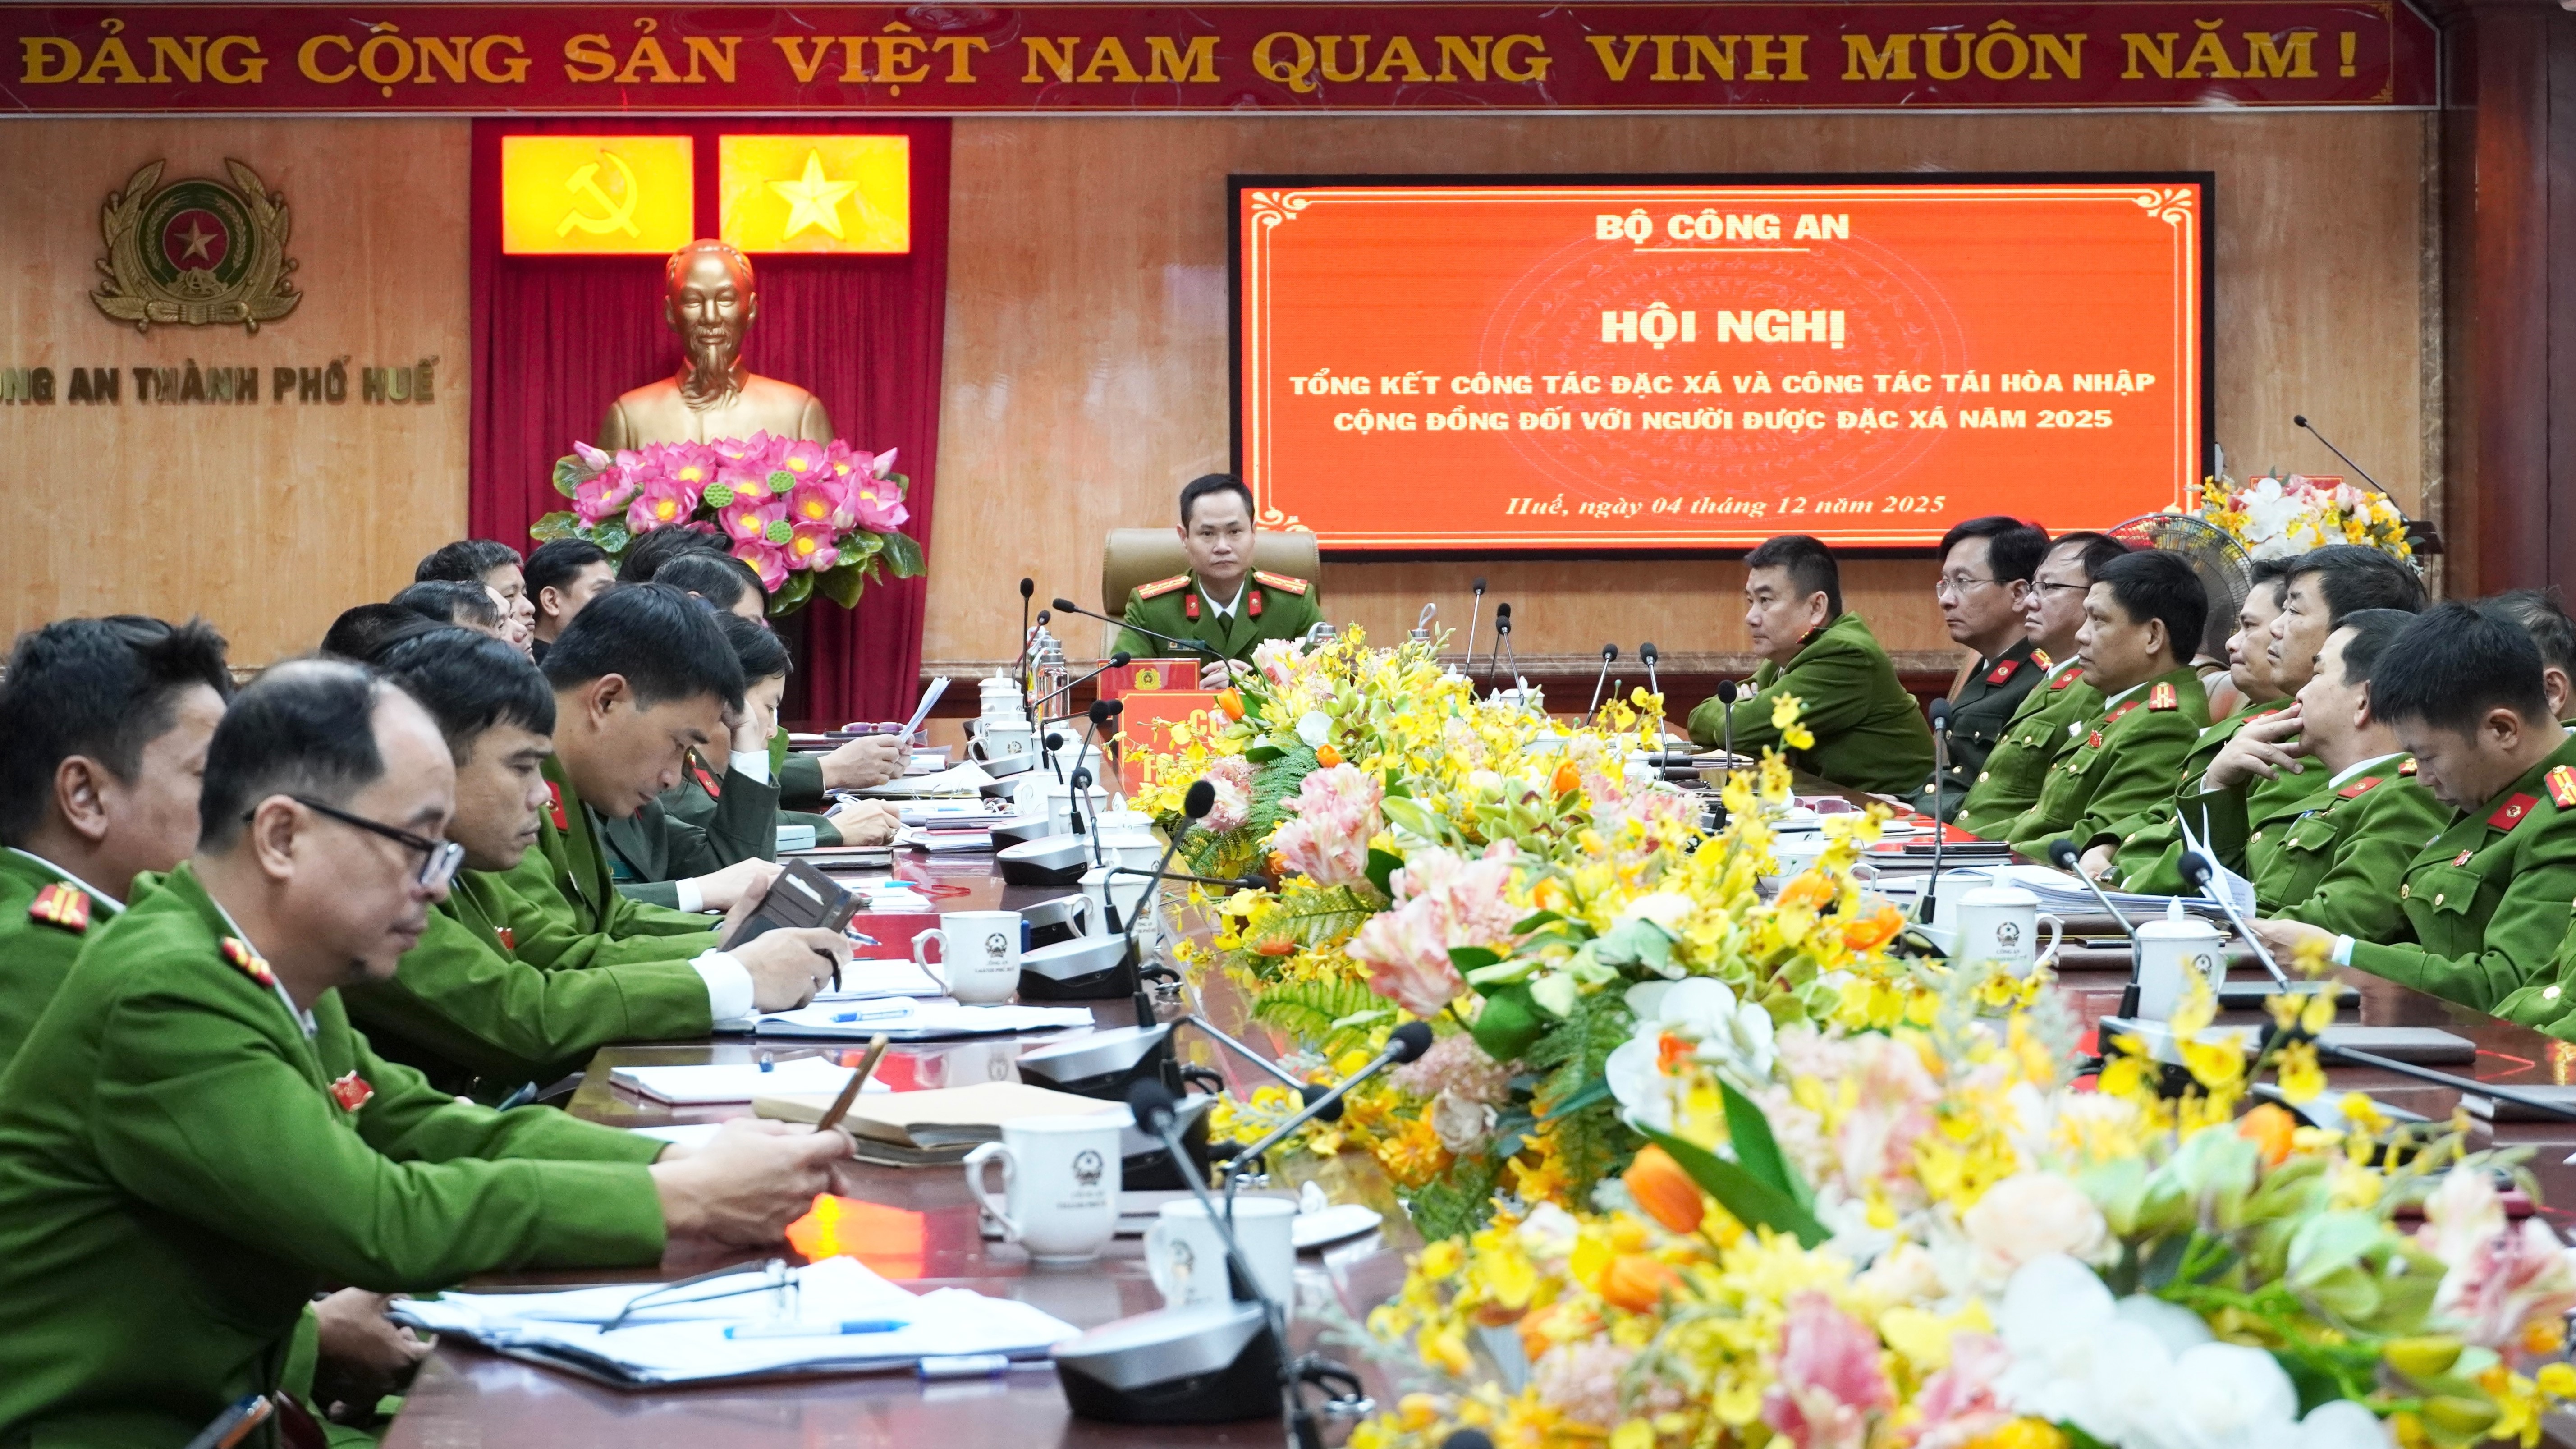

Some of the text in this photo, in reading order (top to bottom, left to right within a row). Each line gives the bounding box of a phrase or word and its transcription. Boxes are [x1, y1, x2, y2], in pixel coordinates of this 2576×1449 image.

[19, 17, 2356, 98] ĐẢNG CỘNG SẢN VIỆT NAM QUANG VINH MUÔN NĂM !
[1595, 208, 1850, 244] BỘ CÔNG AN
[1600, 300, 1846, 350] HỘI NGHỊ
[0, 354, 440, 404] NG AN THÀNH PHỐ HUẾ
[1289, 367, 2156, 399] TỔNG KẾT CÔNG TÁC ĐẶC XÁ VÀ CÔNG TÁC TÁI HÒA NHẬP
[1333, 404, 2113, 436] CỘNG ĐỒNG ĐỐI VỚI NGƯỜI ĐƯỢC ĐẶC XÁ NĂM 2025
[1505, 493, 1946, 519] Huế, ngày 04 tháng 12 năm 2025
